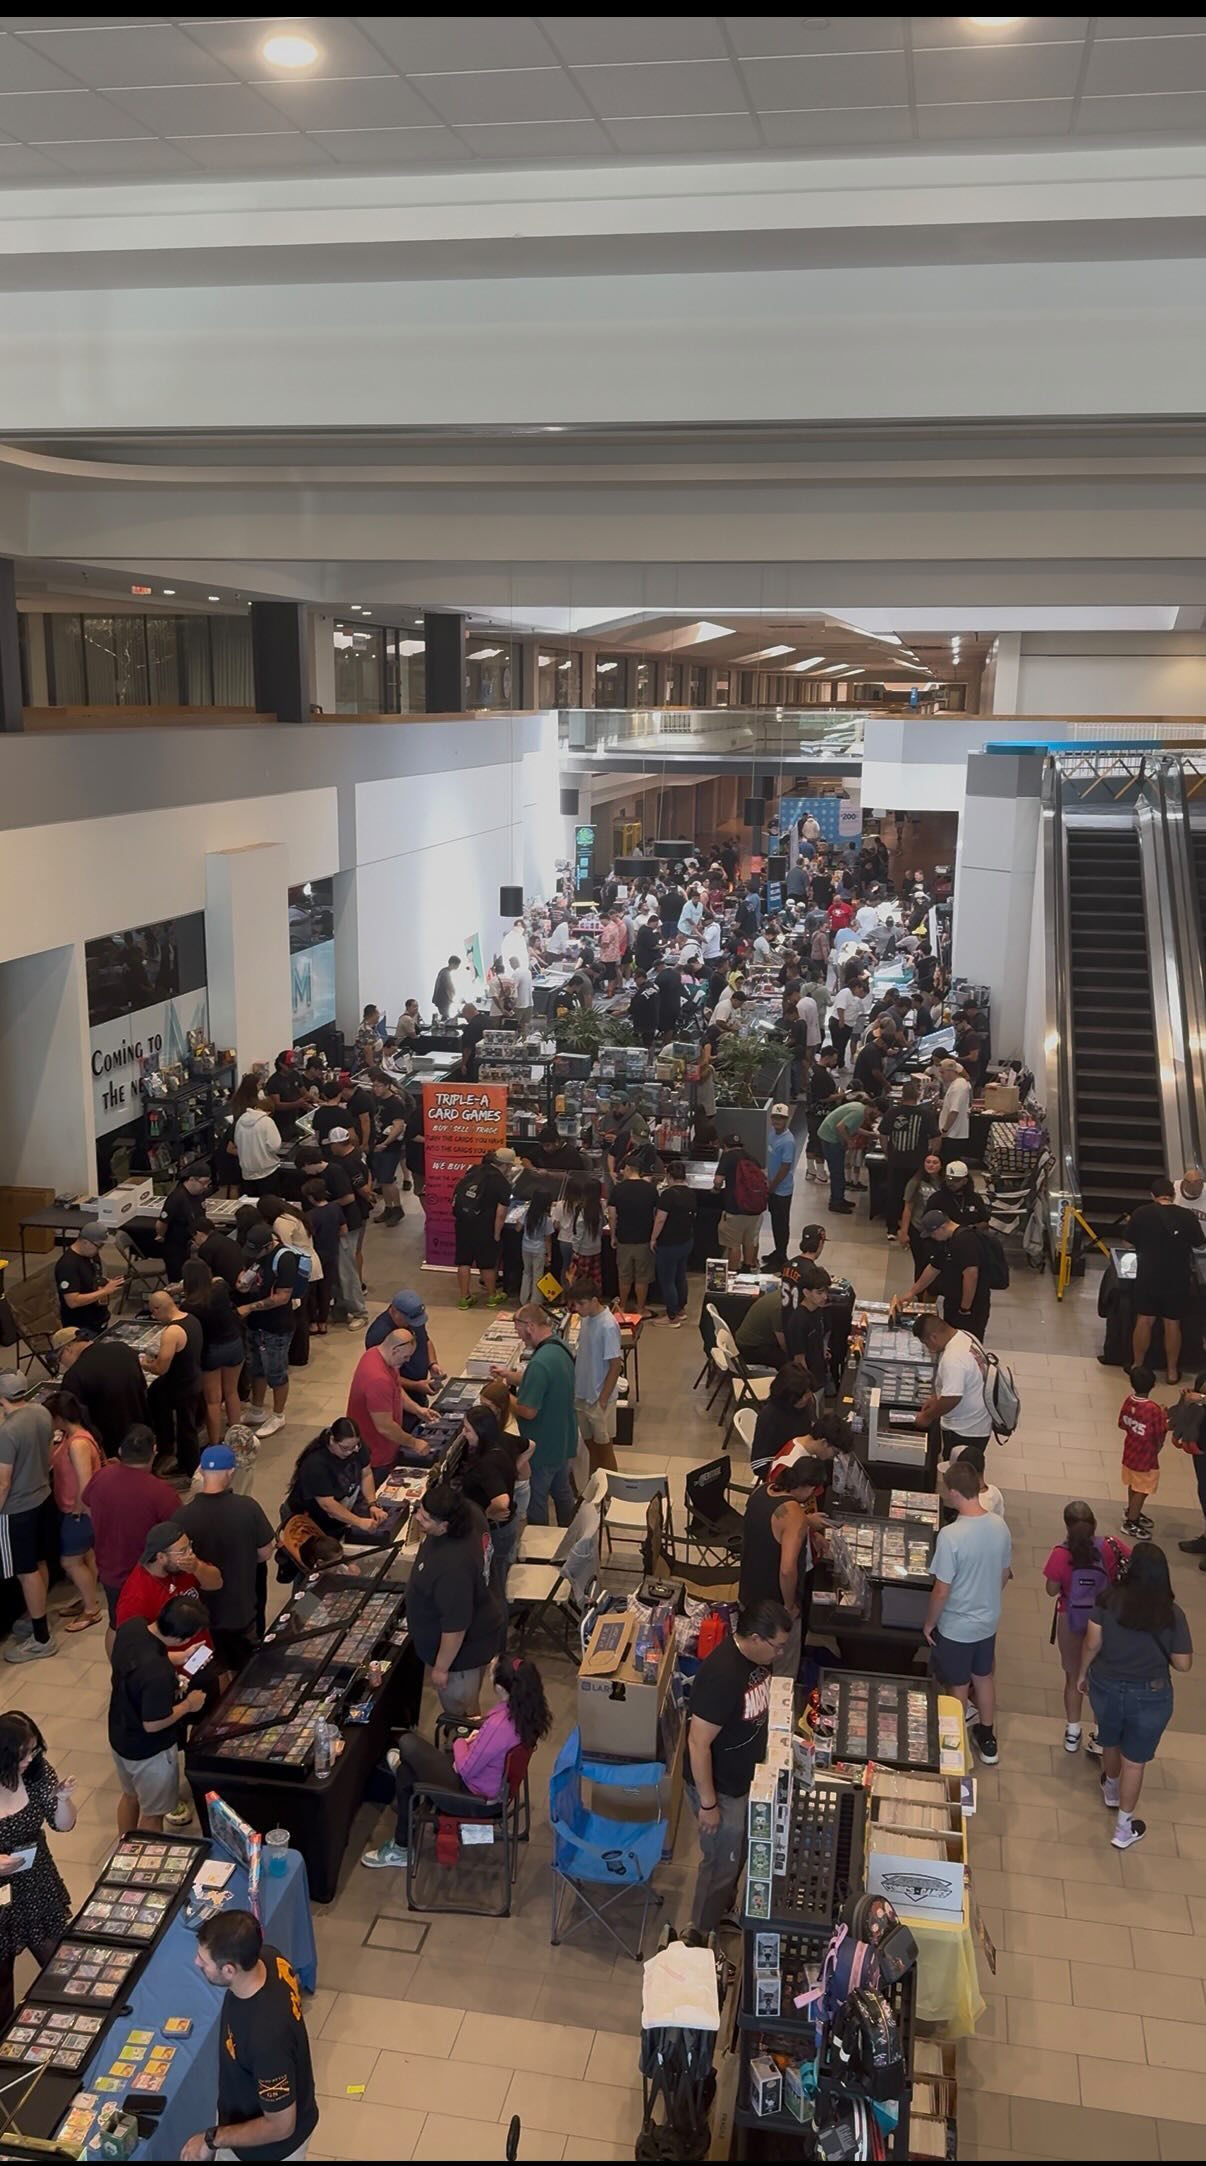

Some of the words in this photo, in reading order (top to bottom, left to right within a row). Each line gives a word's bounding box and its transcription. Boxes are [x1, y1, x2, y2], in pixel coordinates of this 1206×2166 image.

[148, 1033, 162, 1053] TO
[102, 1080, 125, 1110] THE
[435, 1093, 489, 1108] TRIPLE-A
[428, 1108, 459, 1121] CARD
[462, 1109, 502, 1122] GAMES
[432, 1124, 448, 1132] BUY
[453, 1125, 470, 1133] SELL
[454, 1135, 473, 1143] CARDS
[432, 1161, 446, 1170] WE
[447, 1162, 465, 1171] BUY
[781, 1282, 799, 1310] 51
